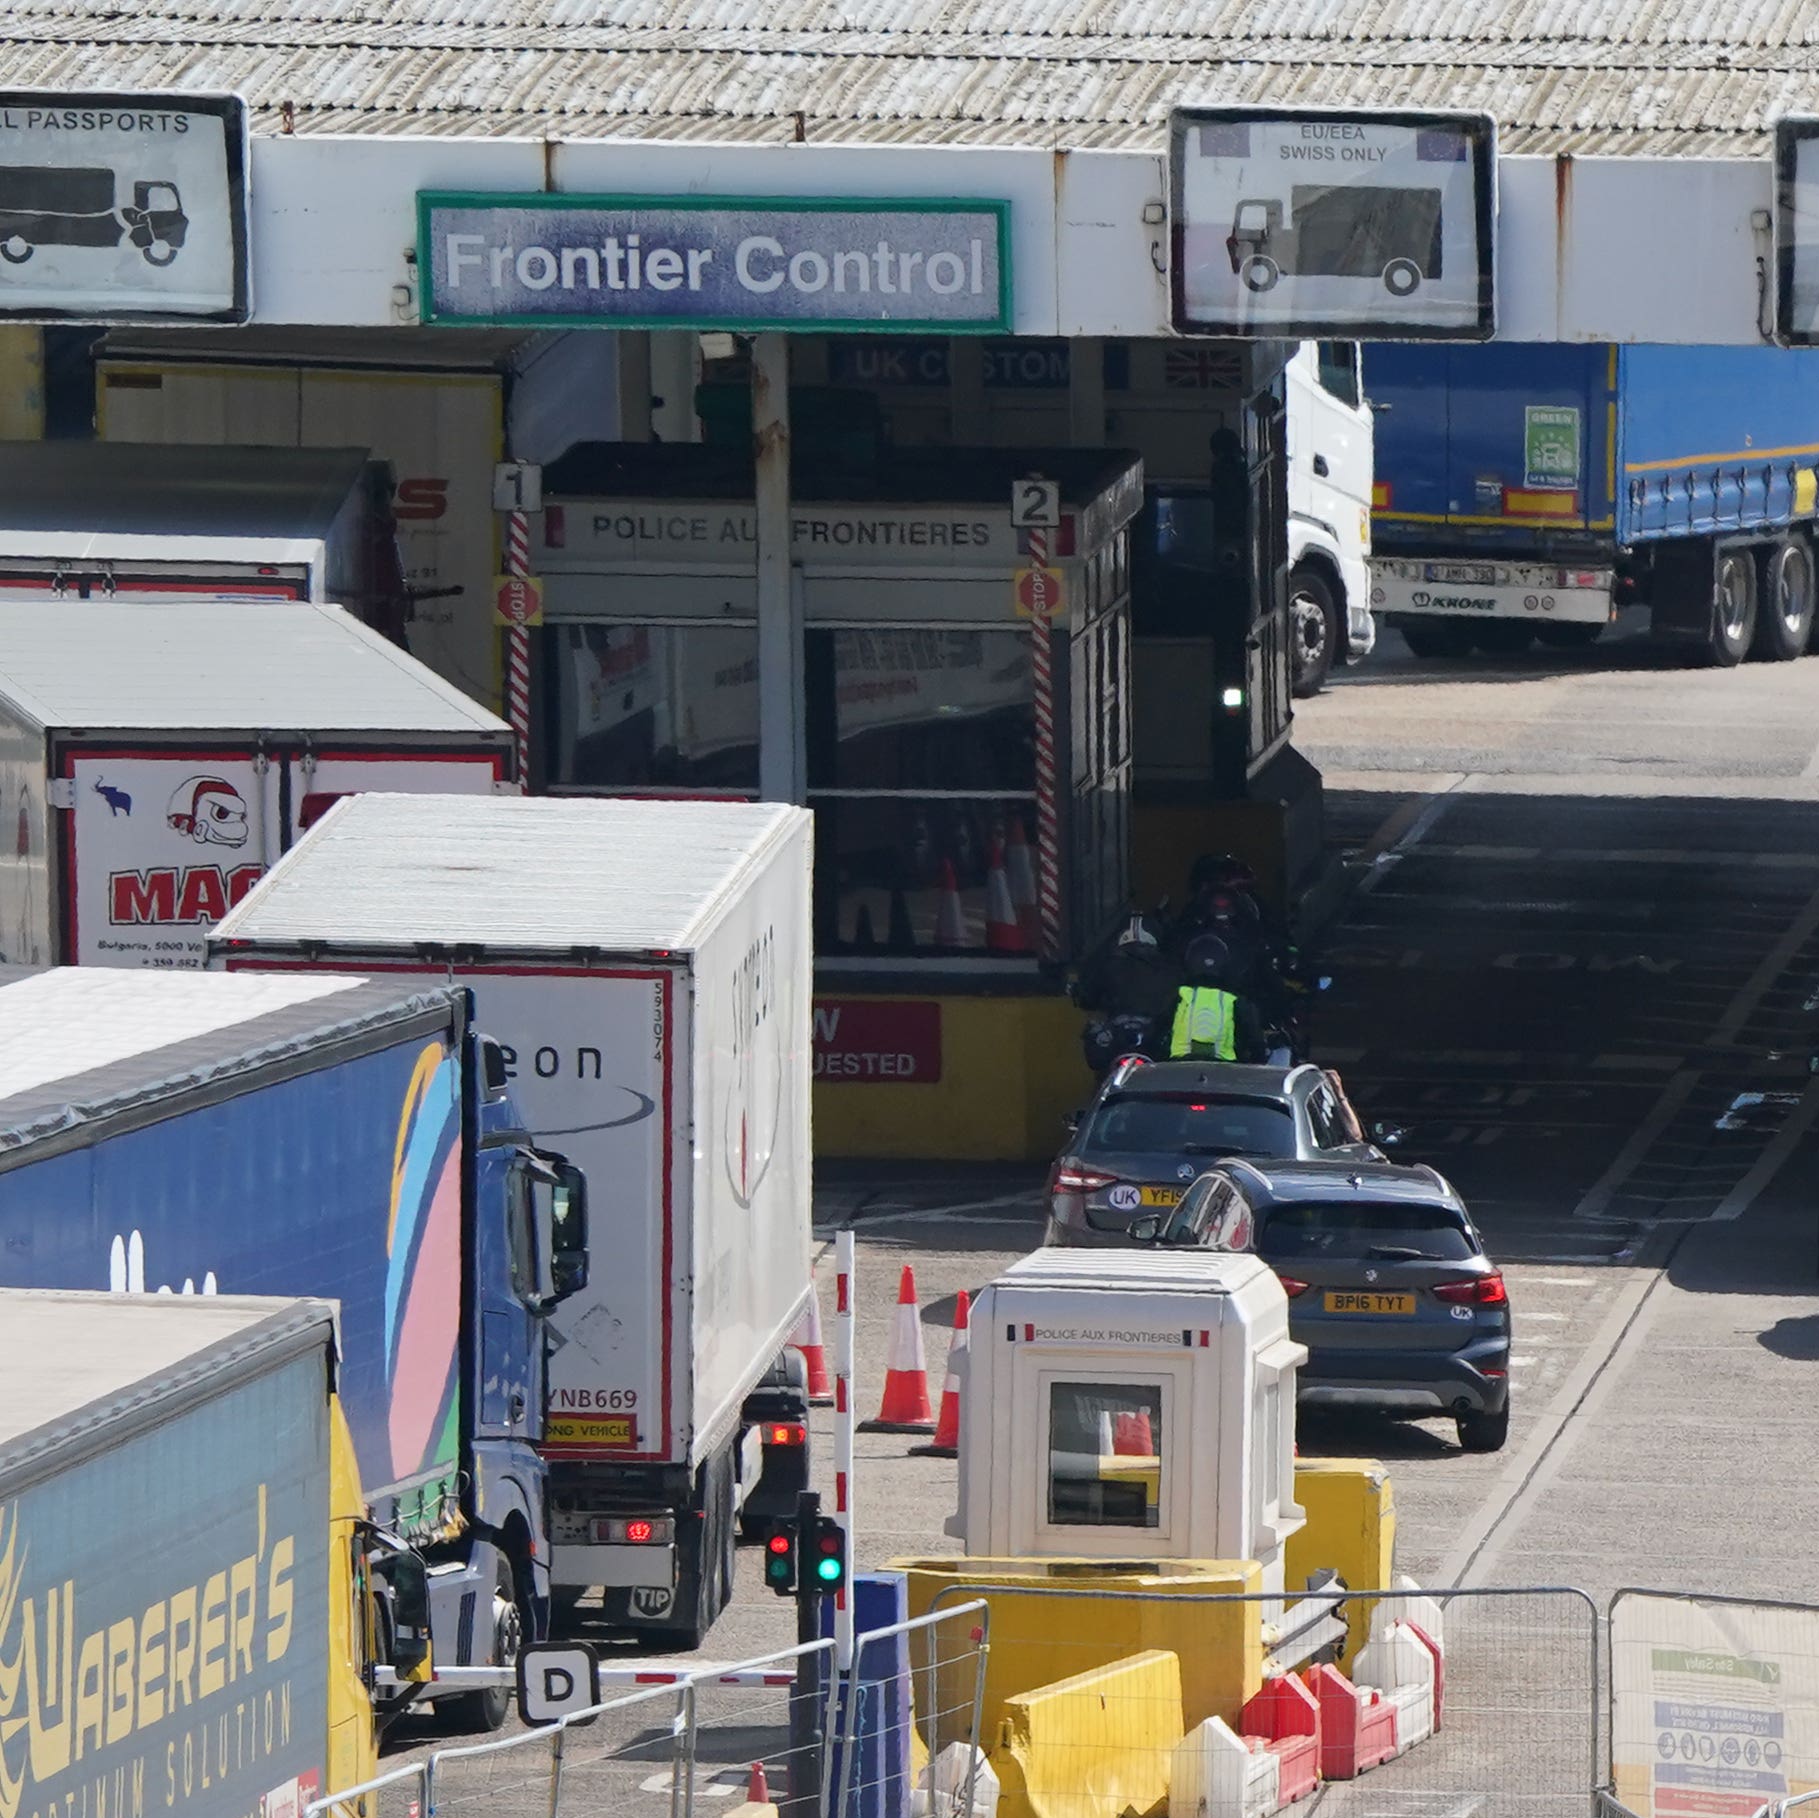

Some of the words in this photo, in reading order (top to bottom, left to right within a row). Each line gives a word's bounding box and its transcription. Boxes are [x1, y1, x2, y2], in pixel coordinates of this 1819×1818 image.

[27, 111, 190, 133] PASSPORTS
[1301, 124, 1366, 140] EU/EEA
[1280, 145, 1335, 161] SWISS
[1341, 147, 1387, 162] ONLY
[446, 232, 715, 291] Frontier
[735, 235, 985, 295] Control
[505, 470, 524, 507] 1
[1022, 485, 1049, 521] 2
[593, 516, 707, 543] POLICE
[719, 517, 758, 543] AU
[794, 518, 990, 547] FRONTIERES
[510, 581, 525, 622] STOP
[1032, 572, 1047, 610] STOP
[652, 982, 664, 1063] 593074
[1113, 1190, 1137, 1207] UK
[1334, 1294, 1371, 1312] BP16
[1373, 1294, 1406, 1313] TYT
[1036, 1328, 1080, 1341] POLICE
[1082, 1330, 1104, 1343] AUX
[1106, 1331, 1182, 1344] FRONTIERES
[580, 1424, 631, 1439] VEHICLE
[637, 1589, 670, 1610] TIP
[543, 1667, 576, 1703] D
[166, 1679, 292, 1806] SOLUTION
